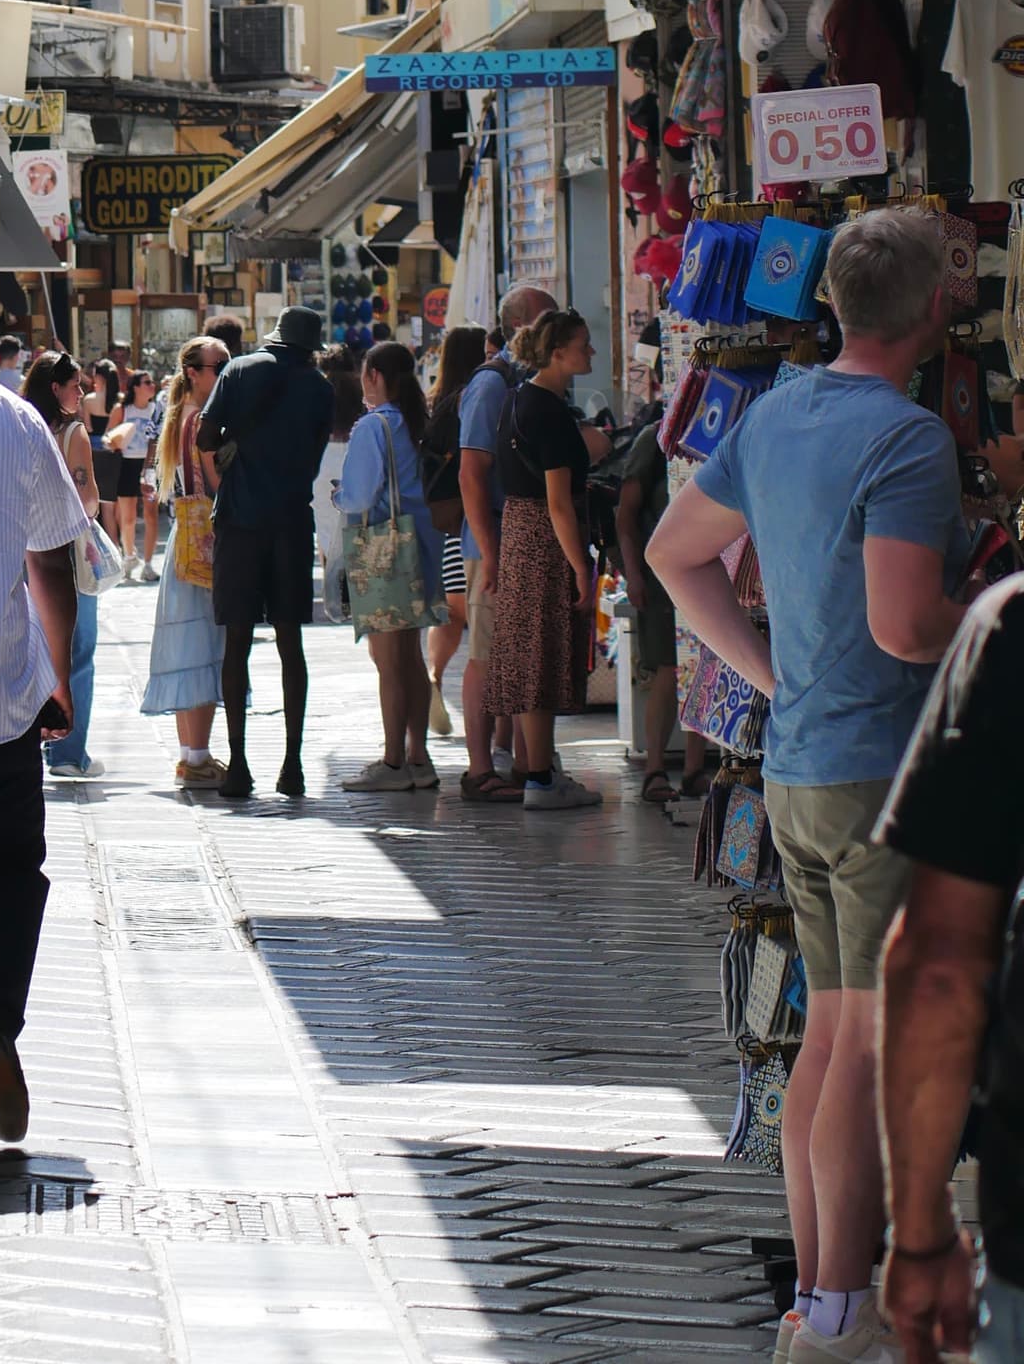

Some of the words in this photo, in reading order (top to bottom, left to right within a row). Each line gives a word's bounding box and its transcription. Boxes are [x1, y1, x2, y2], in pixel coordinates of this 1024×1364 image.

[399, 74, 514, 91] RECORDS
[544, 71, 577, 87] CD
[767, 110, 825, 125] SPECIAL
[827, 105, 871, 119] OFFER
[768, 121, 876, 171] 0,50
[97, 197, 149, 226] GOLD
